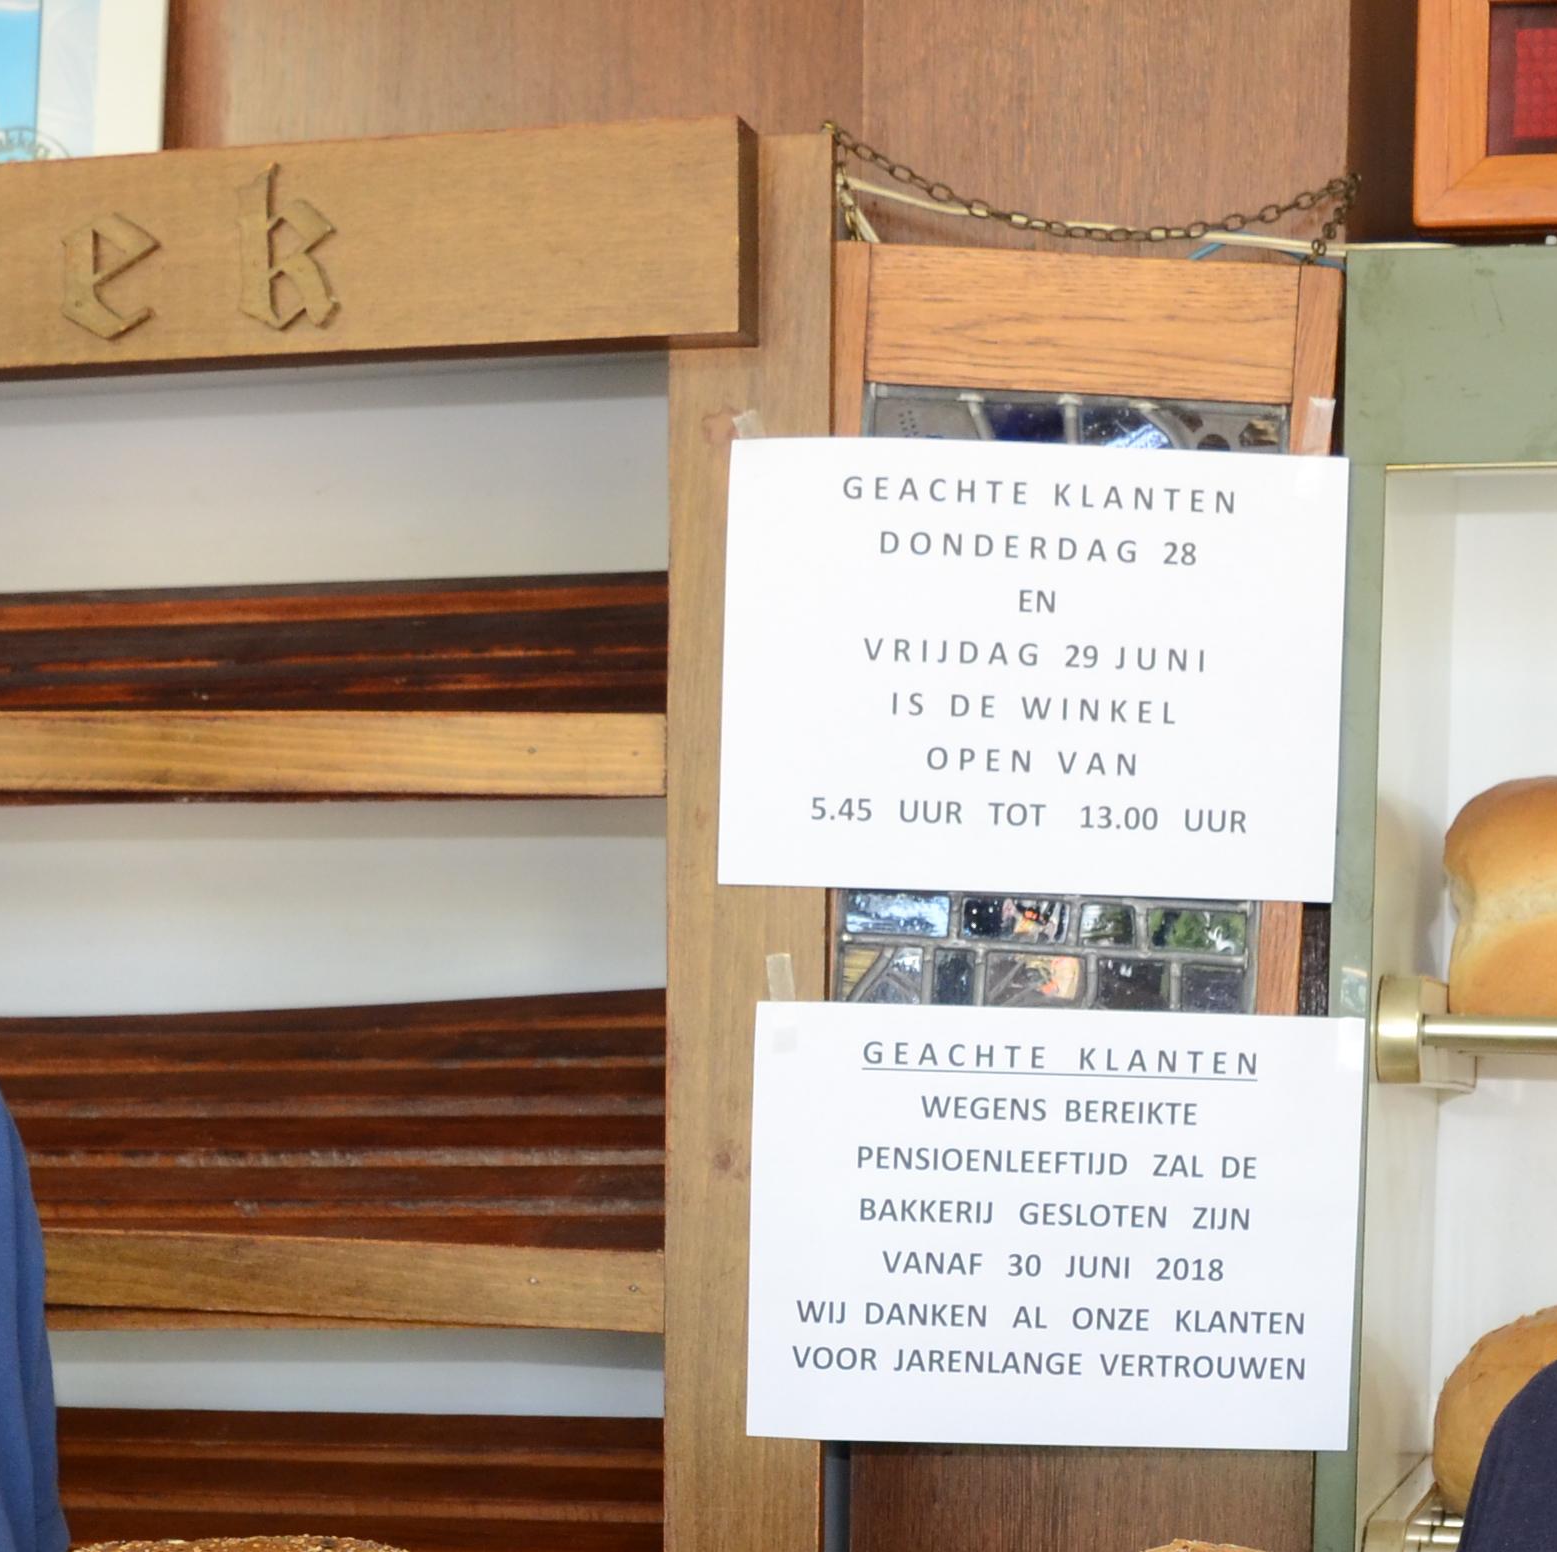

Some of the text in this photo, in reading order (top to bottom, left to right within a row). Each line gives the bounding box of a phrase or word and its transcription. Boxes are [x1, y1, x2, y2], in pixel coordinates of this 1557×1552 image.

[842, 475, 1235, 515] GEACHTE KLANTEN
[880, 530, 1197, 567] DONDERDAG 28
[1018, 589, 1056, 614] EN
[863, 637, 1205, 673] VRIJDAG 29 JUNI
[892, 691, 1176, 725] IS DE WINKEL
[926, 746, 1137, 777] OPEN VAN
[811, 796, 1247, 834] 5.45 UUR TOT 13.00 UUR
[863, 1040, 1257, 1076] GEACHTE KLANTEN
[920, 1095, 1198, 1126] WEGENS BEREIKTE
[857, 1145, 1257, 1180] PENSIOENLEEFTIJD ZAL DE
[859, 1197, 1250, 1231] BAKKERIJ GESLOTEN ZIJN
[881, 1250, 1224, 1282] VANAF 30 JUNI 2018
[796, 1299, 1305, 1336] WIJ DANKEN AL ONZE KLANTEN
[791, 1345, 1306, 1381] VOOR JARENLANGE VERTROUWEN
